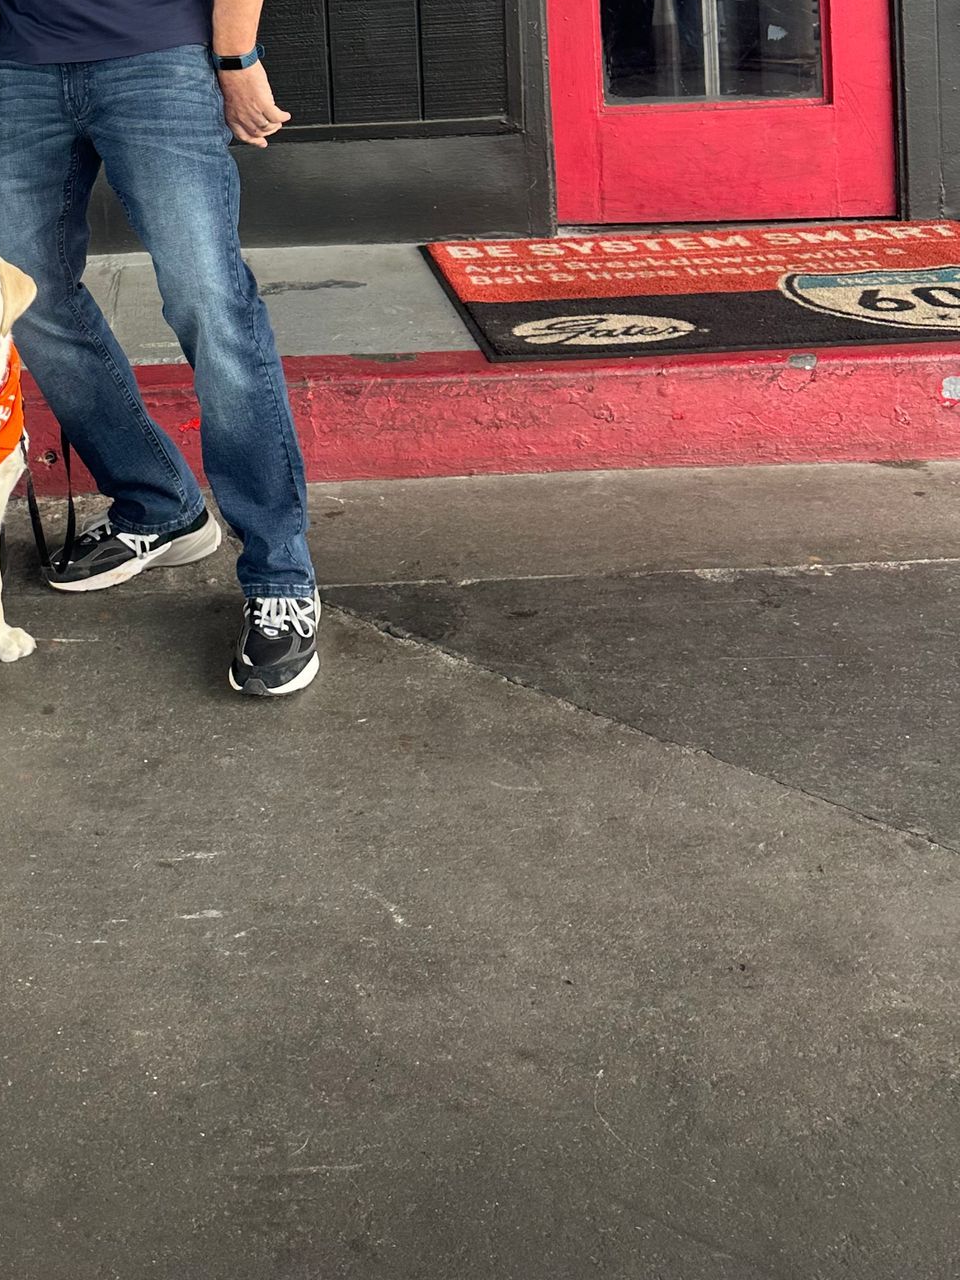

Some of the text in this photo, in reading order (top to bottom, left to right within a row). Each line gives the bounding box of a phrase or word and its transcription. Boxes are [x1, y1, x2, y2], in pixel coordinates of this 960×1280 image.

[444, 224, 956, 259] BE SYSTEM SMART
[464, 247, 906, 274] Avoid Breakdowns with a
[470, 260, 882, 286] Belt & Hose Inspection
[524, 317, 693, 345] Gates
